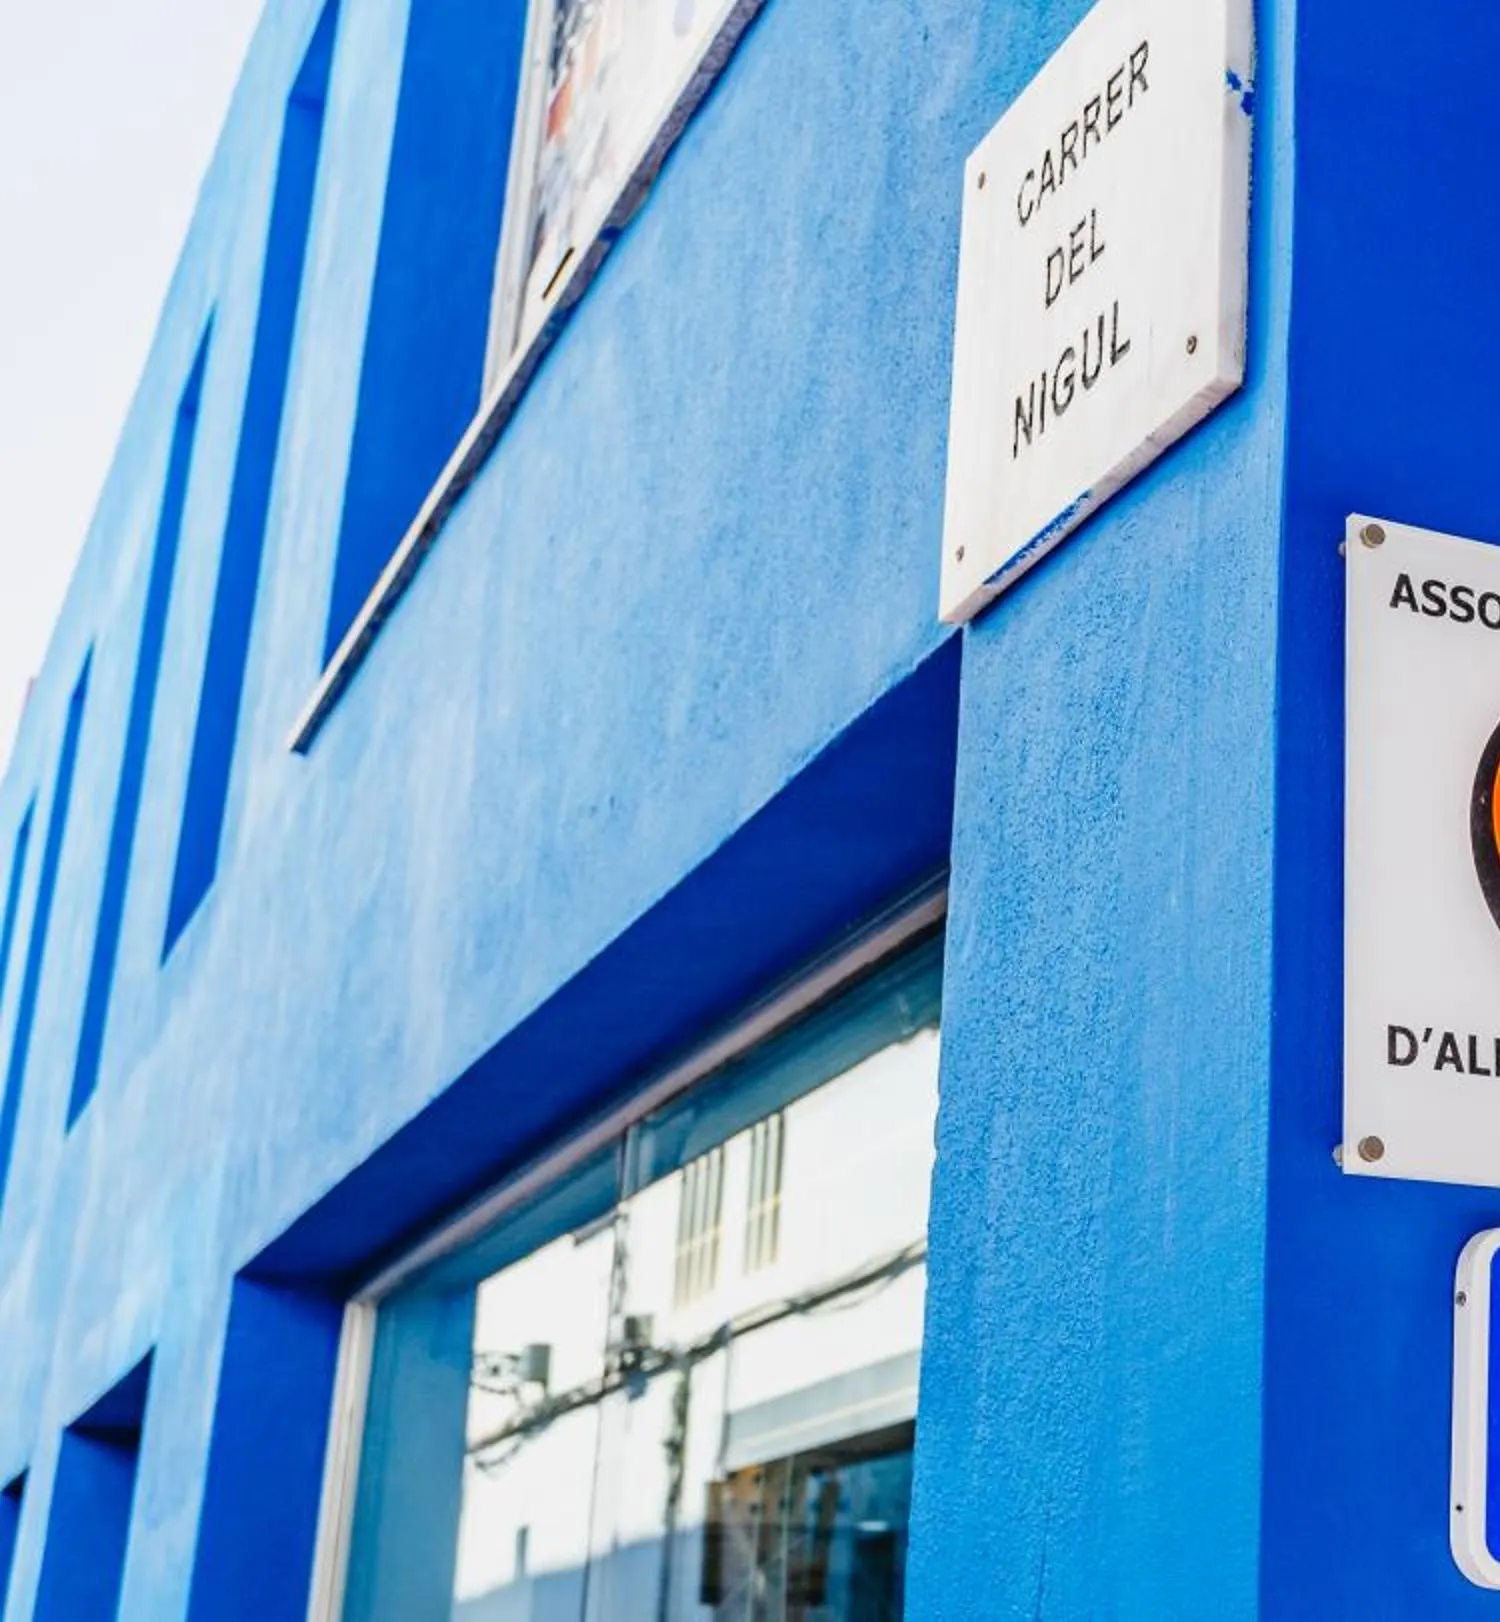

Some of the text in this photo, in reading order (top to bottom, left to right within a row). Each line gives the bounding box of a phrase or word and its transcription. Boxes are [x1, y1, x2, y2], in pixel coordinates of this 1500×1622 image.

[1016, 40, 1150, 228] CARRER
[1044, 208, 1106, 309] DEL
[1012, 300, 1132, 459] NIGUL
